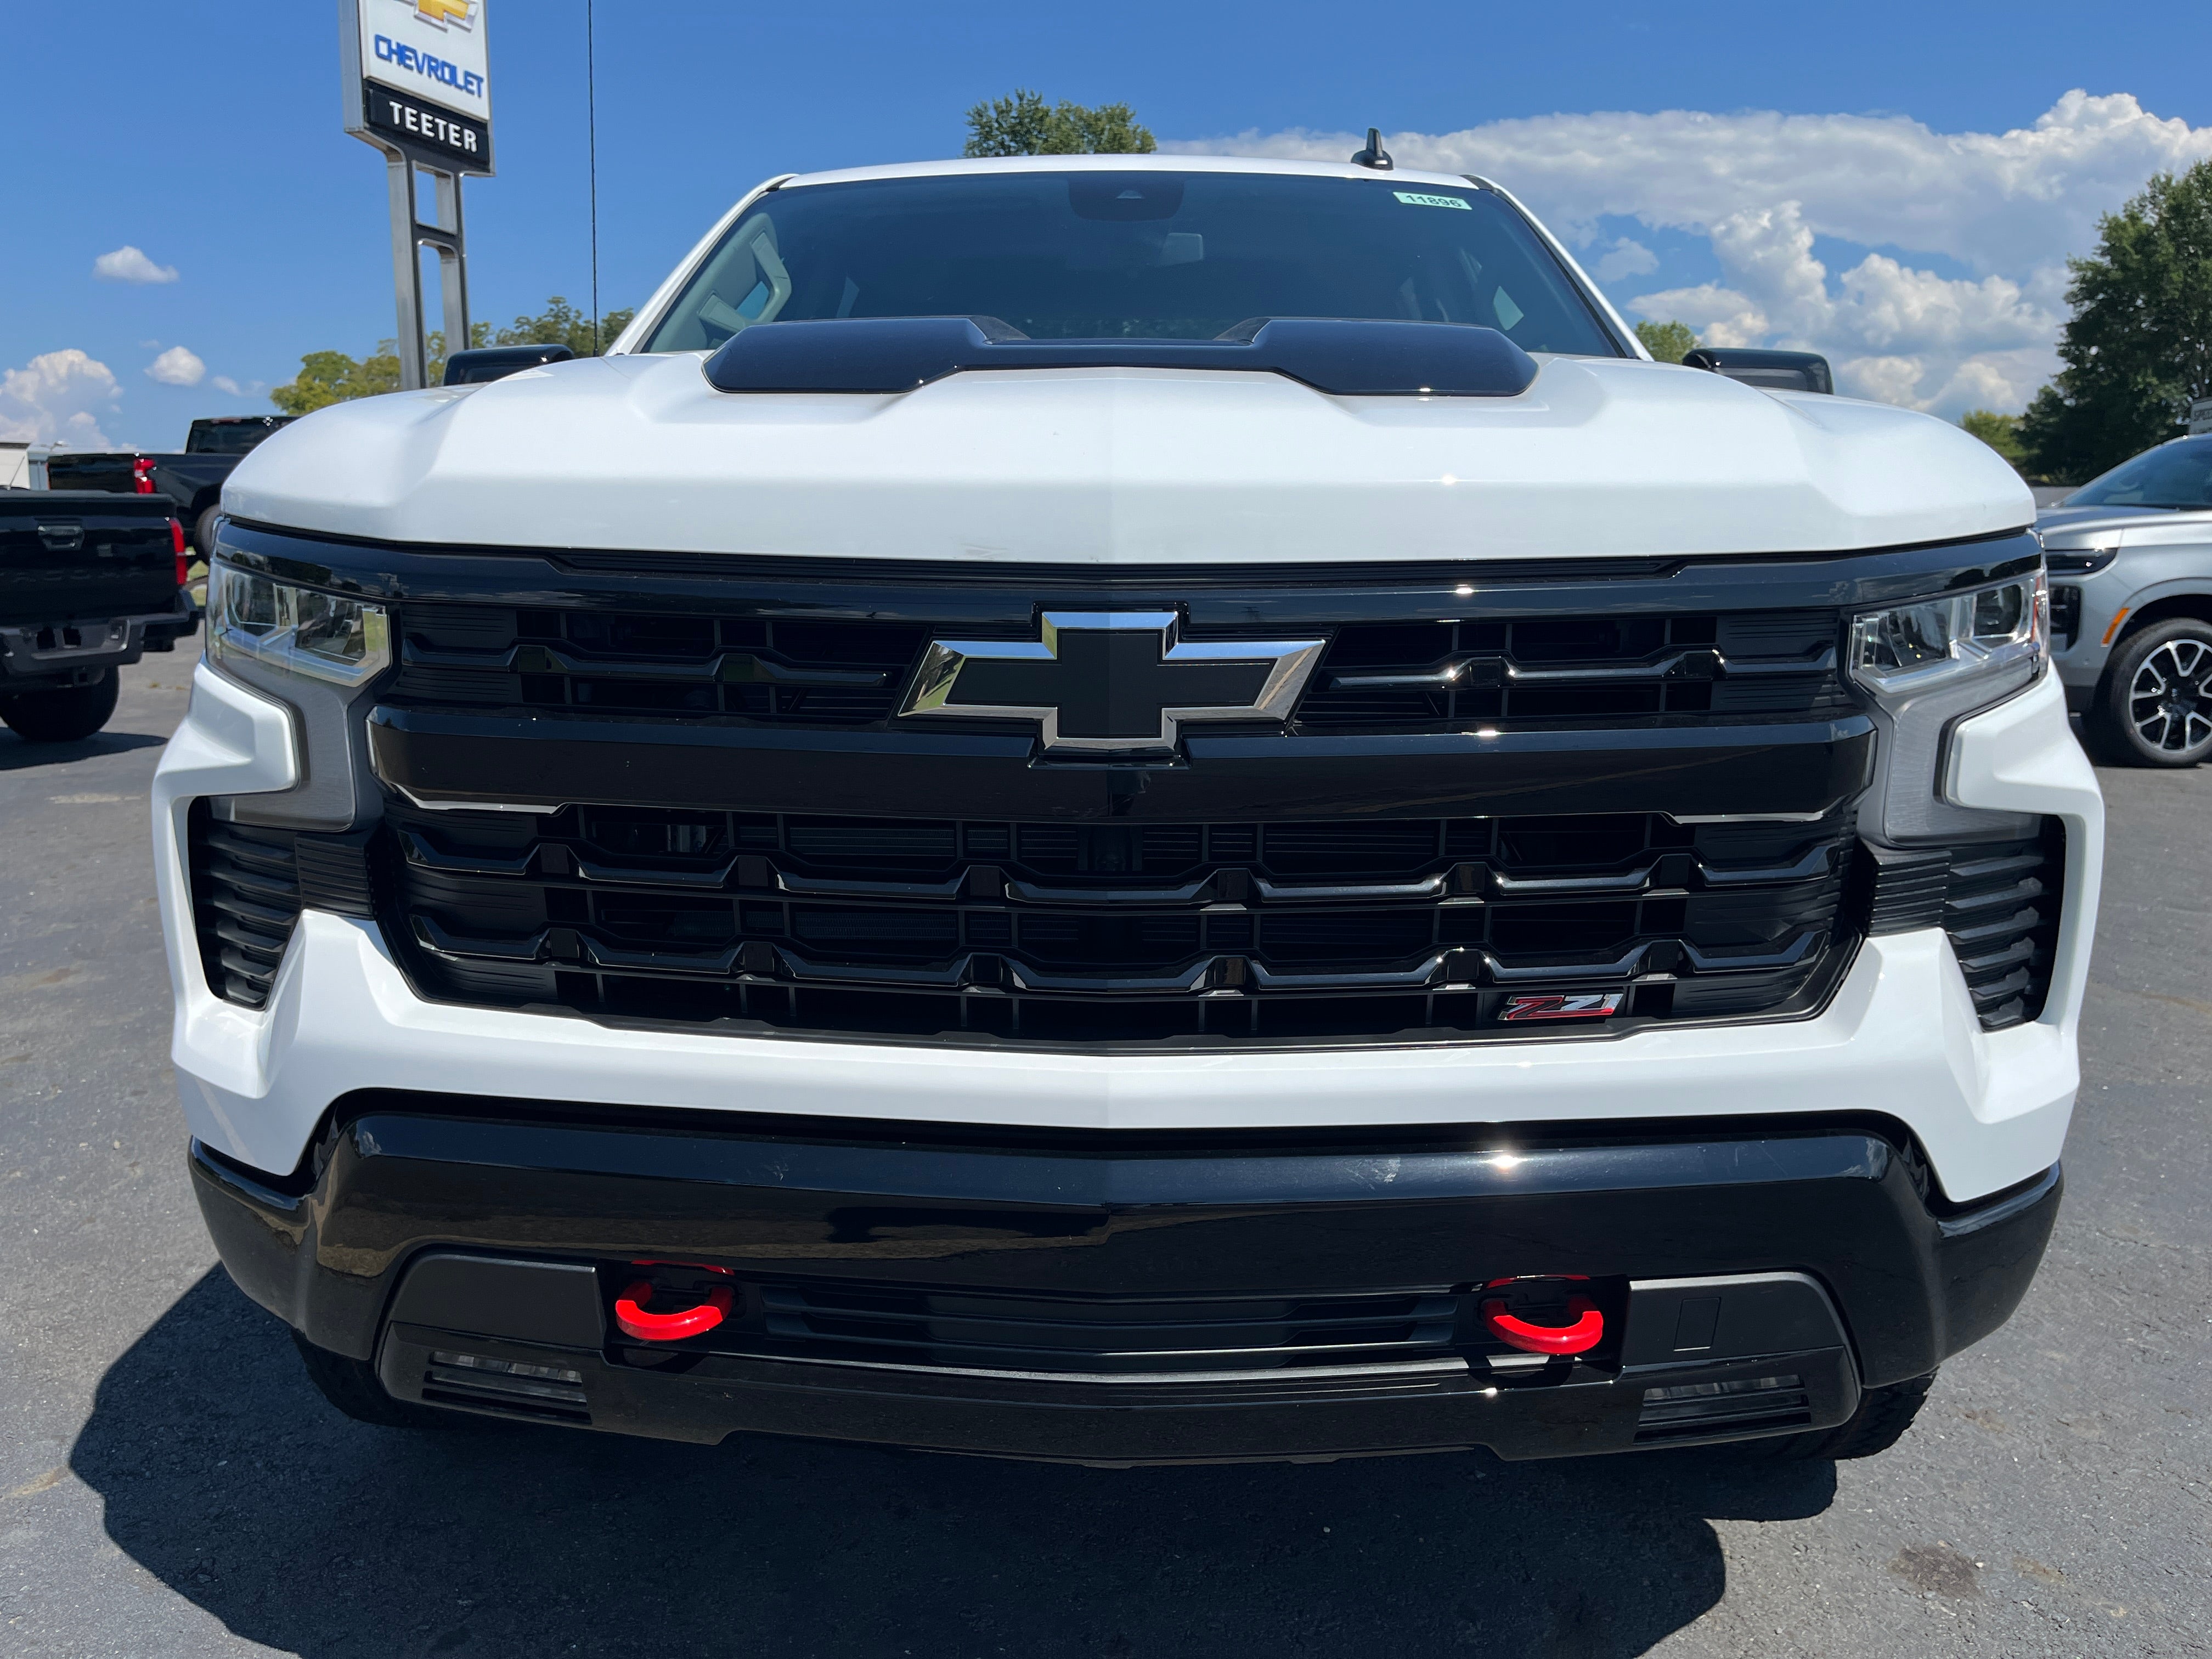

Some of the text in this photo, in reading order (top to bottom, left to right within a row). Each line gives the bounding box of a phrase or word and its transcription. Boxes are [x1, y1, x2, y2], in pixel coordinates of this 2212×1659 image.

[375, 34, 484, 98] CHEVROLET
[389, 100, 478, 153] TEETER
[1406, 195, 1462, 207] 11896
[1498, 994, 1623, 1020] Z71
